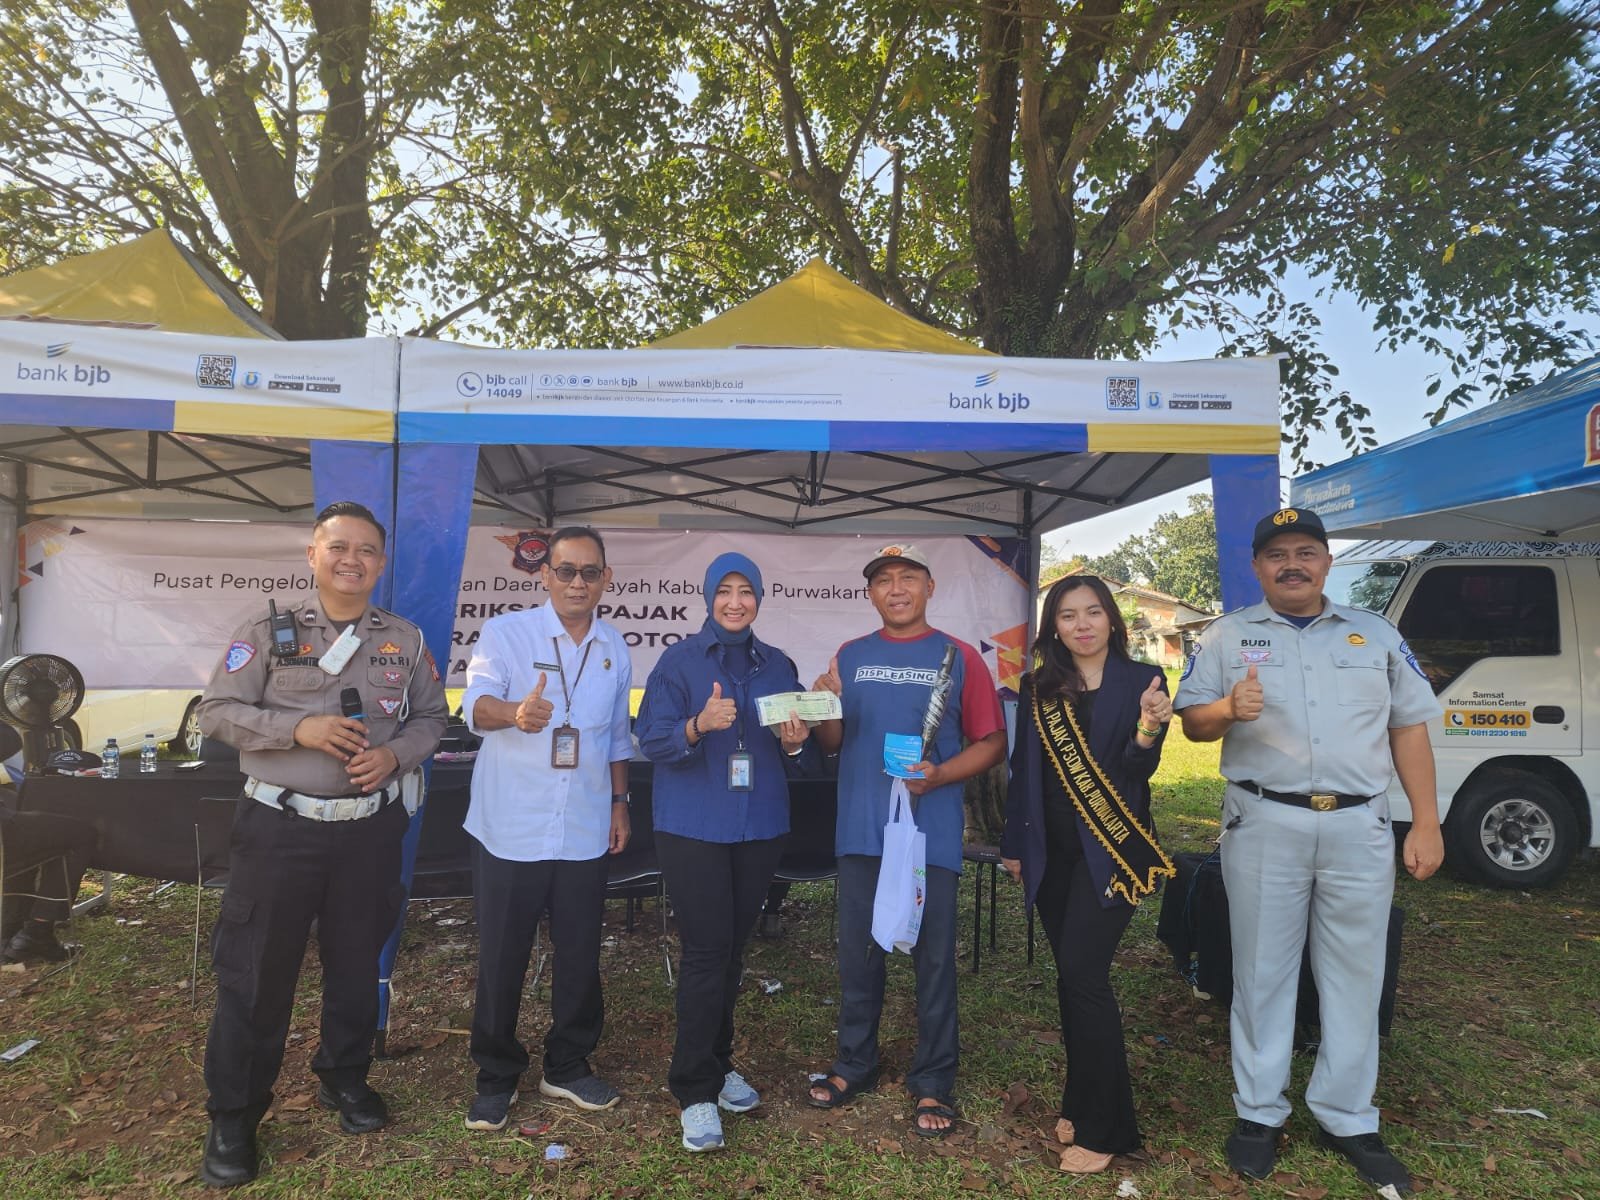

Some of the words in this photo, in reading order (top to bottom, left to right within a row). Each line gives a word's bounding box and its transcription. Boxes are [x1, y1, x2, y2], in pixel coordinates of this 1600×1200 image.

[17, 362, 68, 382] bank
[74, 364, 111, 386] bjb
[486, 374, 506, 386] bjb
[508, 375, 527, 385] call
[597, 377, 620, 386] bank
[621, 377, 638, 388] bjb
[658, 379, 744, 390] www.bankbjb.co.id
[486, 388, 522, 398] 14049
[949, 392, 993, 409] bank
[998, 392, 1030, 413] bjb
[153, 572, 213, 589] Pusat
[220, 573, 319, 593] Pengelol
[606, 579, 651, 596] ayah
[658, 579, 704, 595] Kabu
[772, 583, 869, 600] Purwakart
[597, 605, 688, 621] PAJAK
[1240, 639, 1271, 647] BUDI
[370, 656, 410, 667] POLRI
[857, 670, 934, 682] DISPLEASING
[1472, 691, 1504, 699] Samsat
[1449, 699, 1497, 707] Information
[1498, 699, 1527, 707] Center
[1470, 714, 1497, 726] 150
[1499, 714, 1526, 726] 410
[1046, 711, 1072, 747] PAJAK
[1060, 743, 1086, 774] P3DW
